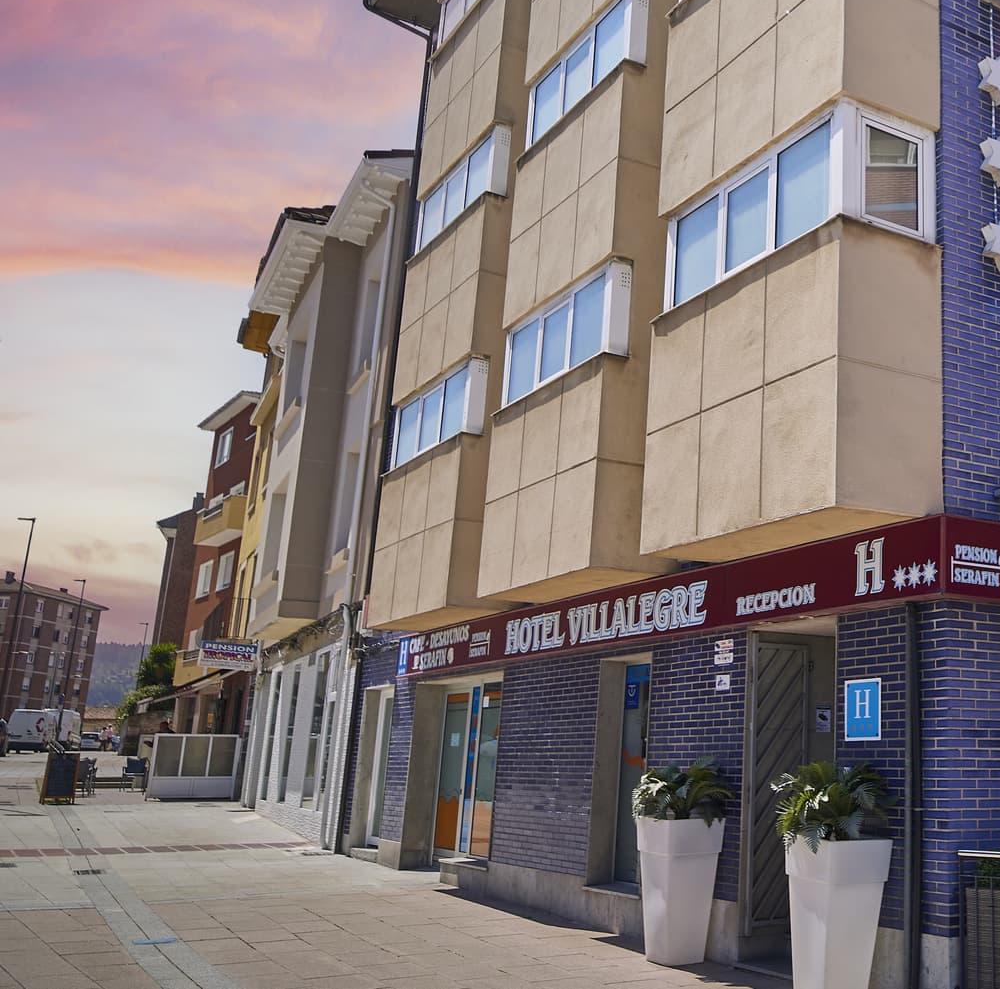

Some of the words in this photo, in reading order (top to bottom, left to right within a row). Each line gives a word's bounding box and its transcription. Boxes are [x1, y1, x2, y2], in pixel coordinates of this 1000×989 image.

[955, 544, 998, 564] PENSION
[854, 537, 885, 596] H
[954, 568, 1000, 587] SERAFIN
[735, 582, 816, 617] RECEPCION
[504, 611, 566, 655] HOTEL
[567, 580, 708, 646] VILLALEGRE
[205, 643, 254, 653] PENSION
[429, 625, 469, 648] DESAYUNOS
[420, 649, 447, 670] SERAFIN
[853, 689, 871, 719] H
